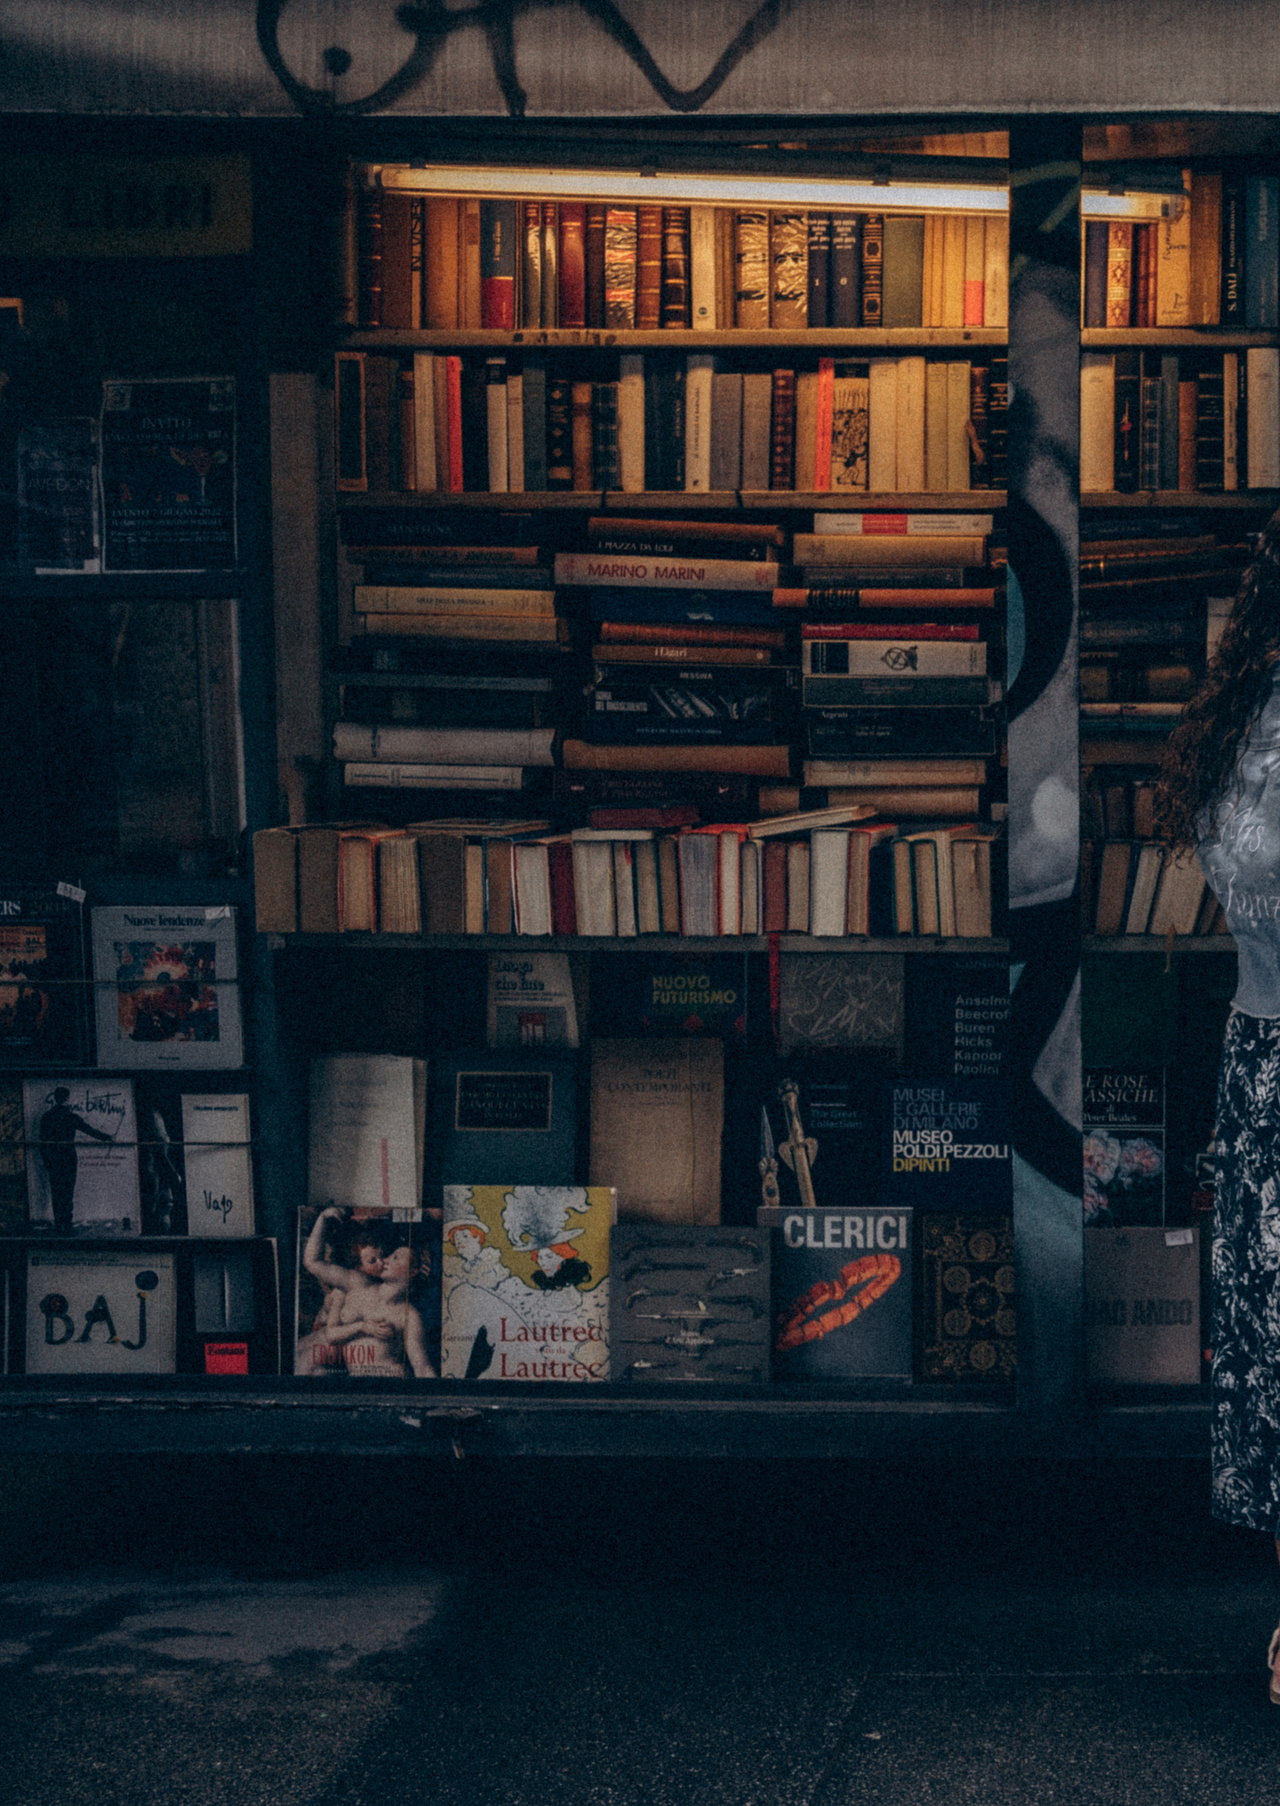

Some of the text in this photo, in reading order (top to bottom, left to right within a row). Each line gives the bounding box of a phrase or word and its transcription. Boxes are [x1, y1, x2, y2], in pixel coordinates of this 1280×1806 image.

[62, 182, 212, 229] LIBRI
[28, 476, 91, 492] AVEDON
[588, 563, 705, 581] MARINO MARINI
[123, 914, 205, 926] Nuove Tendenze
[652, 975, 710, 989] NUOVO
[652, 990, 737, 1005] FUTURISMO
[955, 1008, 1010, 1019] Beecrof
[955, 1022, 995, 1033] Buren
[955, 1036, 992, 1047] Hicks
[955, 1050, 1002, 1061] Kapoor
[955, 1063, 999, 1074] Paolini
[1102, 1074, 1148, 1089] ROSE
[893, 1088, 945, 1101] MUSEI
[1084, 1089, 1159, 1103] ASSICHE
[893, 1102, 982, 1116] E GALLERIE
[893, 1116, 979, 1130] DI MILANO
[892, 1130, 954, 1144] MUSEO
[892, 1144, 1009, 1159] POLDI PEZZOLI
[892, 1158, 950, 1172] DIPINTI
[783, 1214, 907, 1249] CLERICI
[1131, 1299, 1193, 1326] ANDO
[500, 1317, 603, 1342] Lautrec
[312, 1344, 375, 1365] EROTIKON
[500, 1353, 603, 1378] Lautrec
